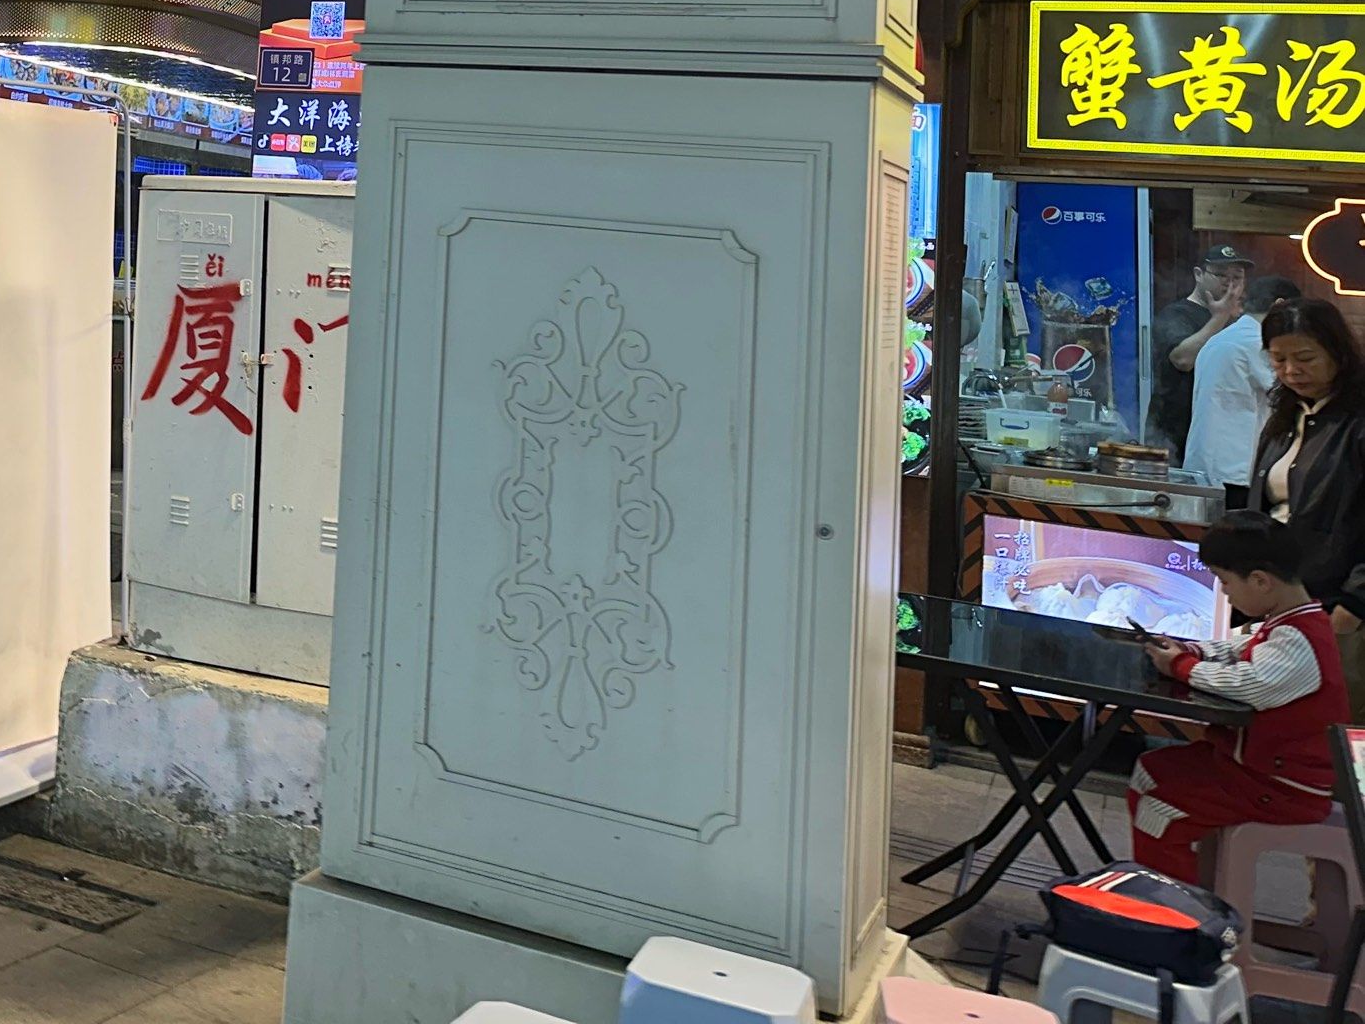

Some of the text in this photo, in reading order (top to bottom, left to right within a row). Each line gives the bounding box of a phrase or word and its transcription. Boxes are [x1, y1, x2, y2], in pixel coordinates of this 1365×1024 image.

[273, 67, 291, 82] 12
[1059, 22, 1365, 133] 蟹黄汤
[267, 97, 362, 131] 大洋海
[319, 135, 359, 157] 上榜
[1063, 210, 1106, 223] 百事可乐
